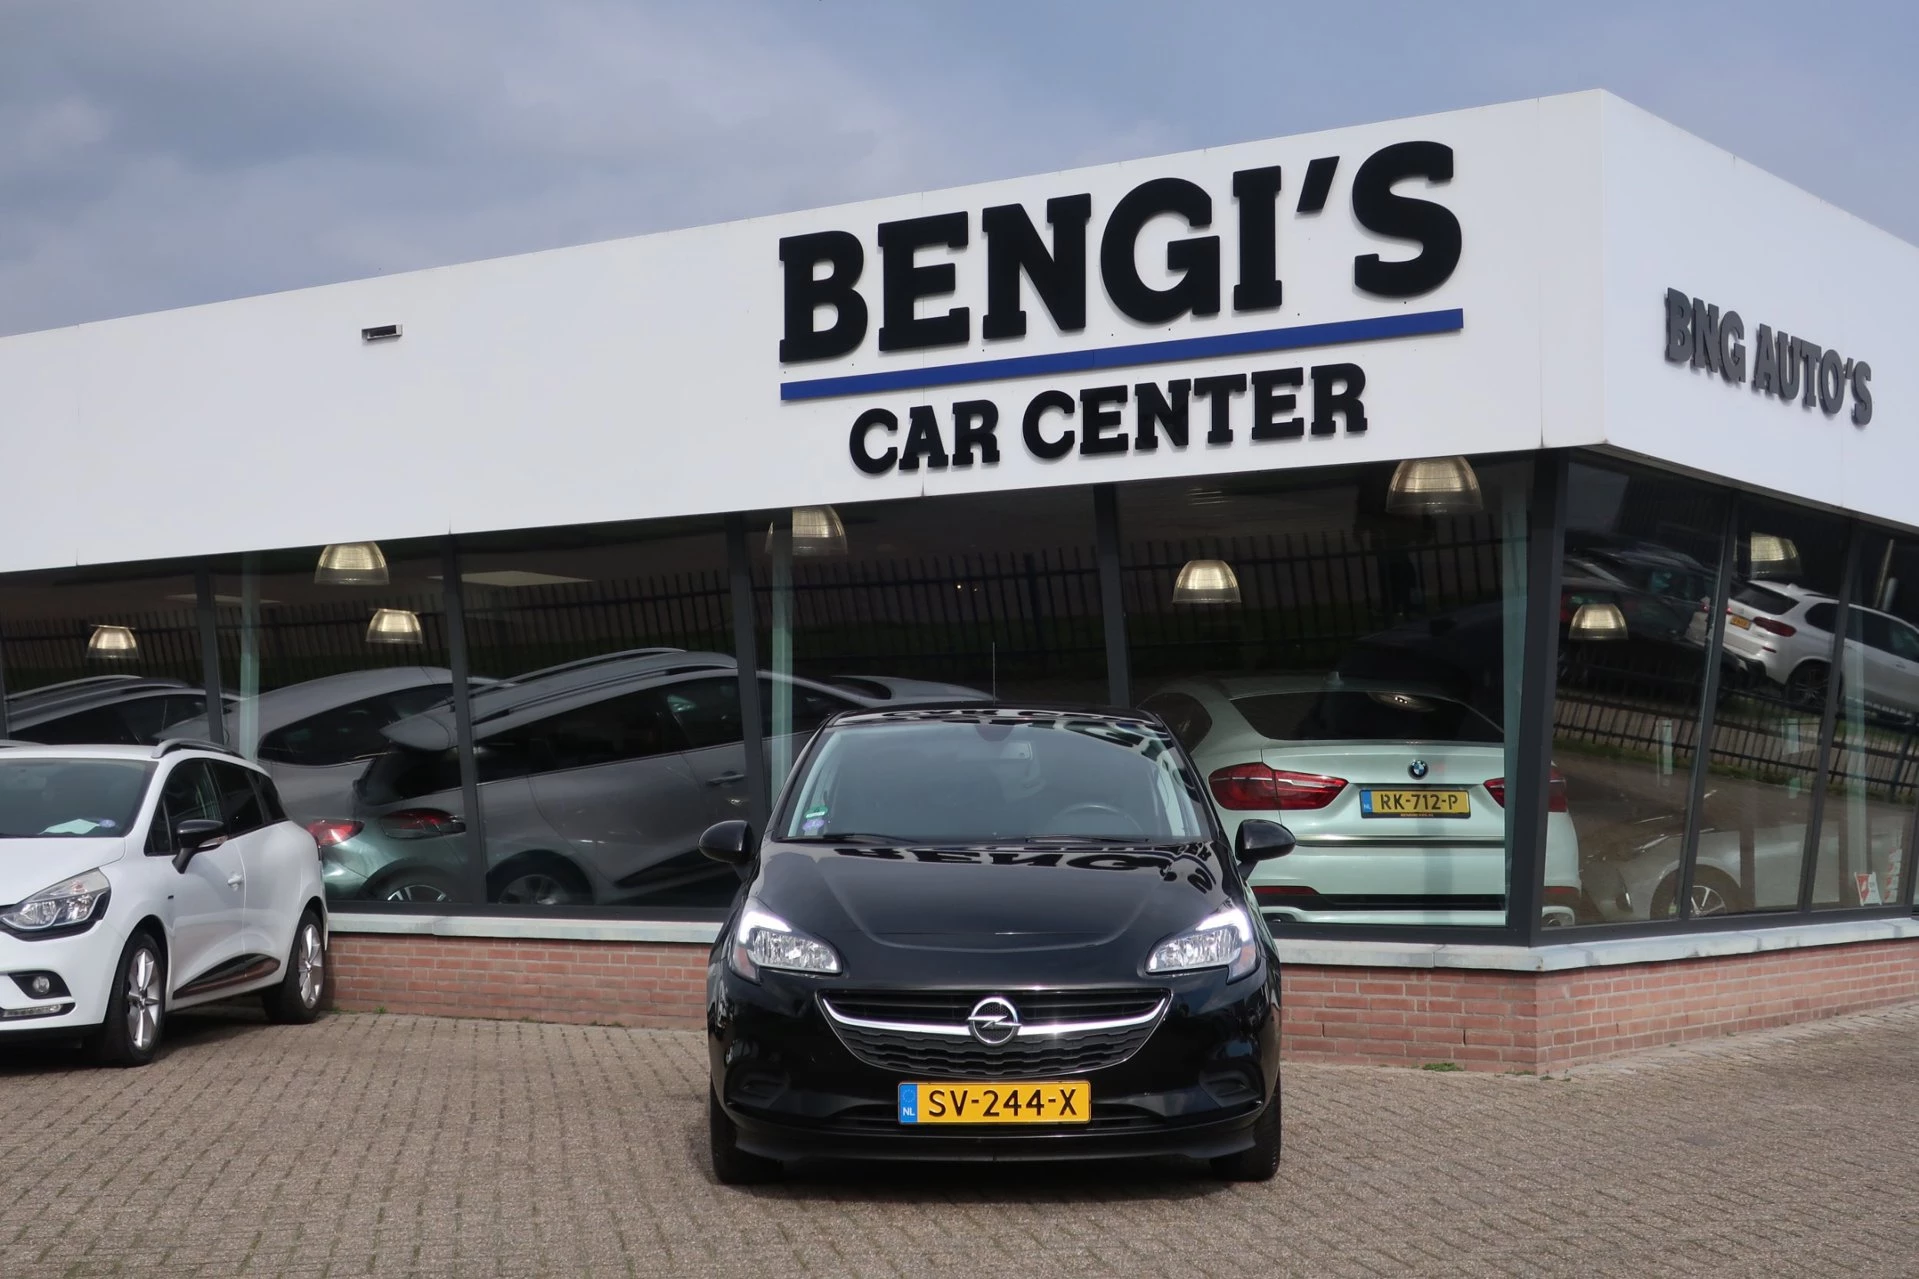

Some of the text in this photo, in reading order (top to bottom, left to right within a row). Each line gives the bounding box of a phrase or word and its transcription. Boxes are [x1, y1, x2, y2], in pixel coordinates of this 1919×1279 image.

[779, 141, 1462, 363] BENGI'S
[1664, 287, 1873, 427] BNG AUTO'S
[849, 363, 1368, 475] CAR CENTER
[1380, 793, 1458, 810] RK-712-P
[902, 1107, 915, 1117] NL
[928, 1089, 1077, 1117] SV-244-X
